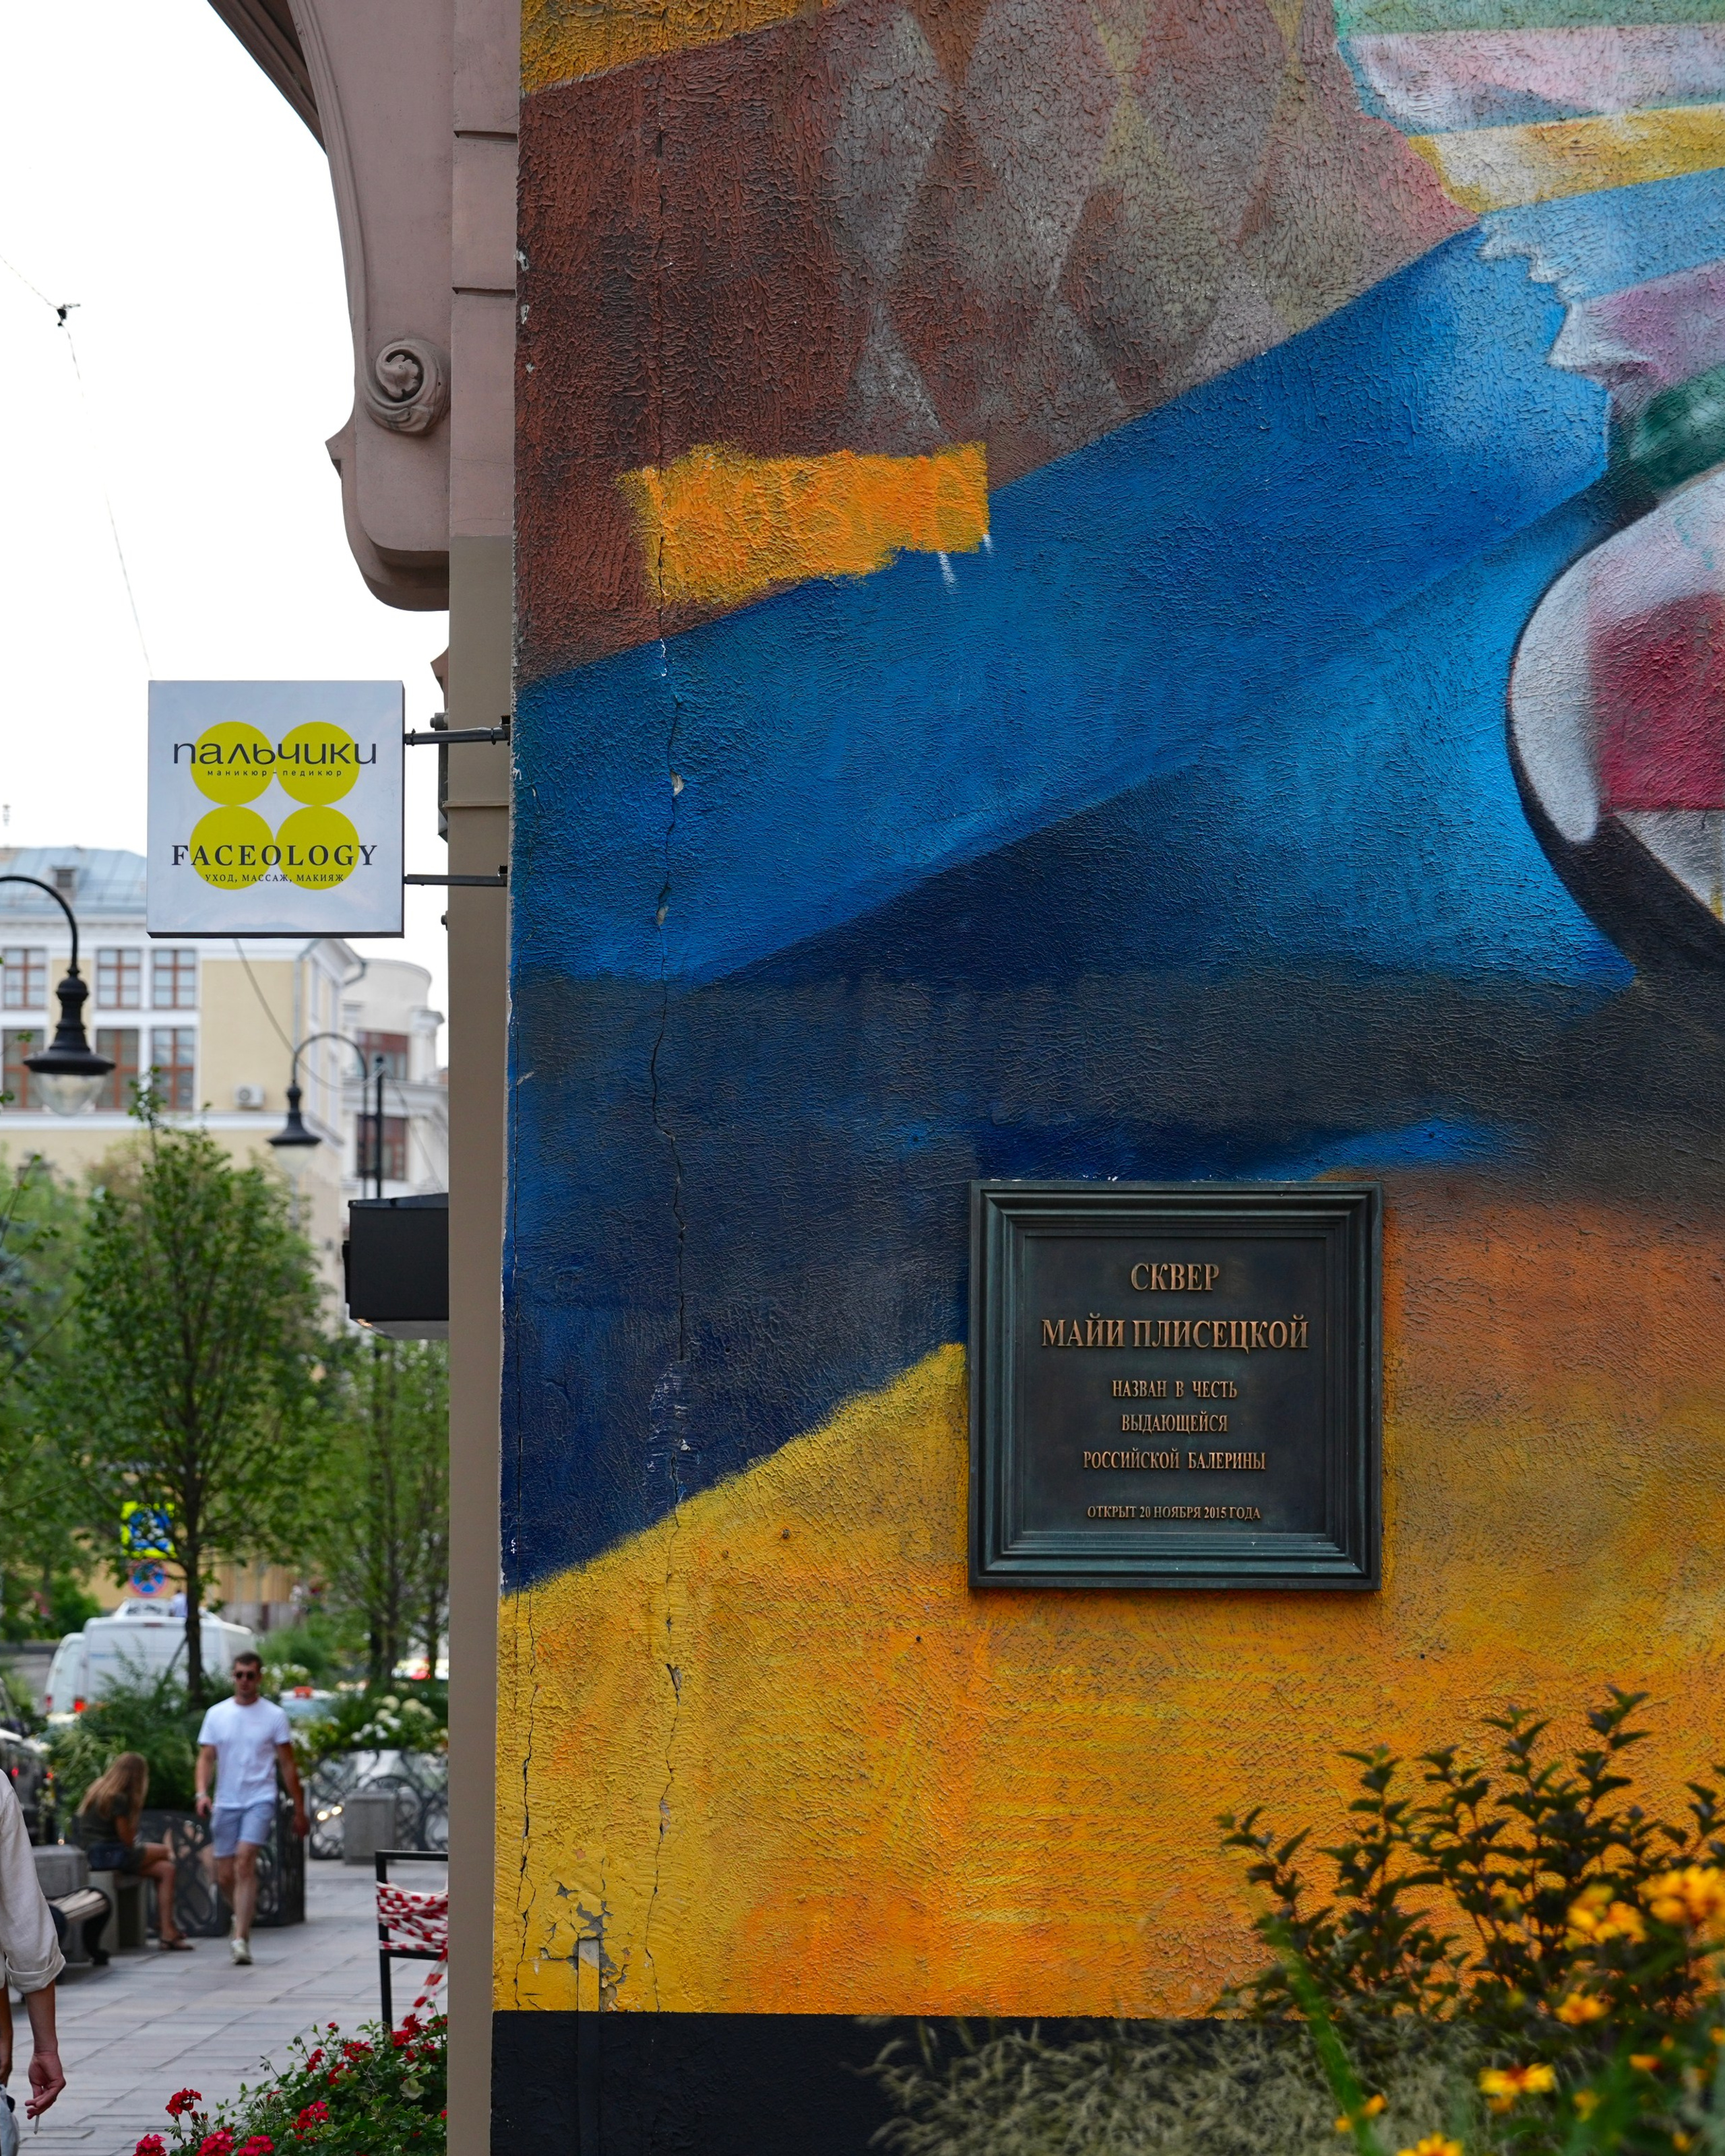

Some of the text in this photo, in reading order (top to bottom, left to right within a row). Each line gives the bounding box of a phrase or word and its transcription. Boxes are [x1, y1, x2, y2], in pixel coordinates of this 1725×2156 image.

[173, 742, 377, 765] пальчики
[171, 844, 377, 866] FACEOLOGY
[205, 874, 344, 883] УХОД, МАССАЖ, МАКИЯЖ
[1130, 1263, 1220, 1291] СКВЕР
[1042, 1312, 1309, 1354] МАЙИ ПЛИСЕЦКОЙ
[1112, 1380, 1238, 1399] НАЗВАН В ЧЕСТЬ
[1121, 1411, 1228, 1434] ВЫДАЮЩЕЙСЯ
[1083, 1448, 1266, 1470] РОССИЙСКОЙ БАЛЕРИНЫ
[1087, 1506, 1261, 1520] ОТКРЫТ 20 НОЯБРЯ 2015 ГОДА
